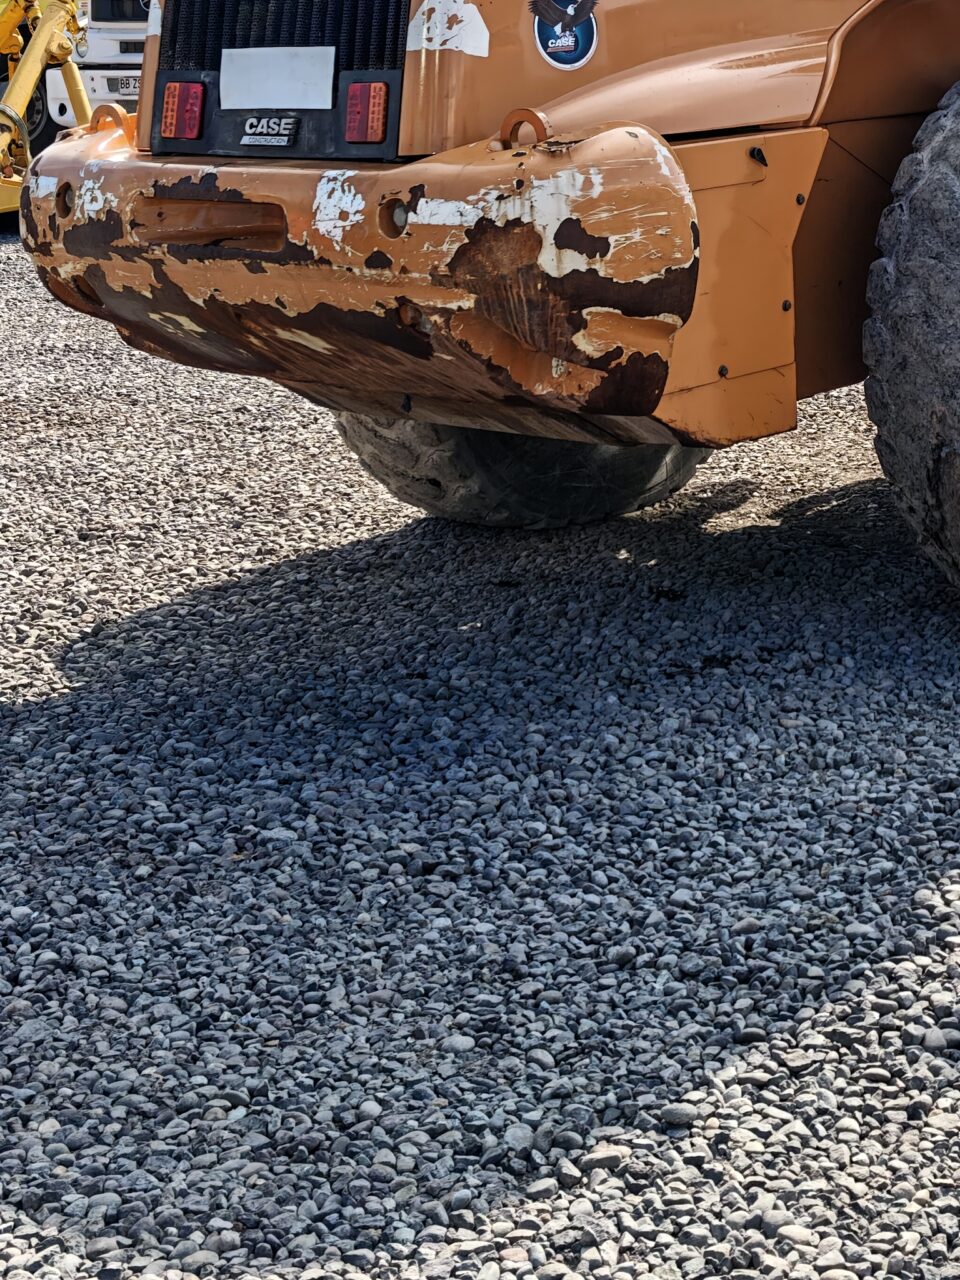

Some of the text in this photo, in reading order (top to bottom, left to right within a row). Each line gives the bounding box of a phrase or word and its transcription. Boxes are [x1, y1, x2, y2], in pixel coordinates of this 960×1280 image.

[547, 37, 576, 48] CASE
[120, 78, 131, 89] BB
[244, 117, 296, 135] CASE
